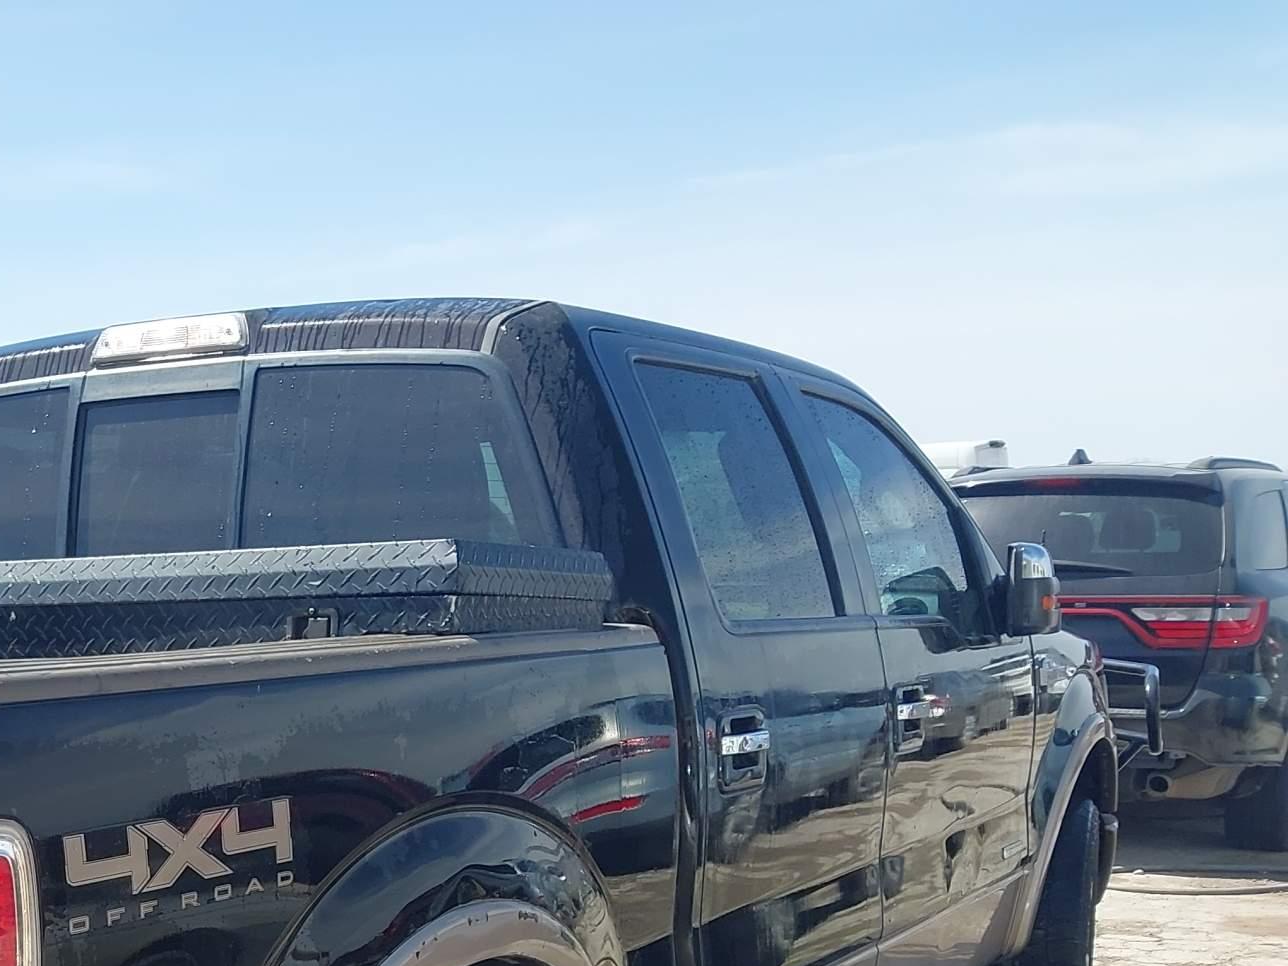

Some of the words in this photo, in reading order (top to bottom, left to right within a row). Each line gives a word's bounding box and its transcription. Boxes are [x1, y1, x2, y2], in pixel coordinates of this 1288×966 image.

[63, 798, 294, 896] 4X4
[69, 900, 159, 935] OFF
[181, 870, 294, 910] ROAD
